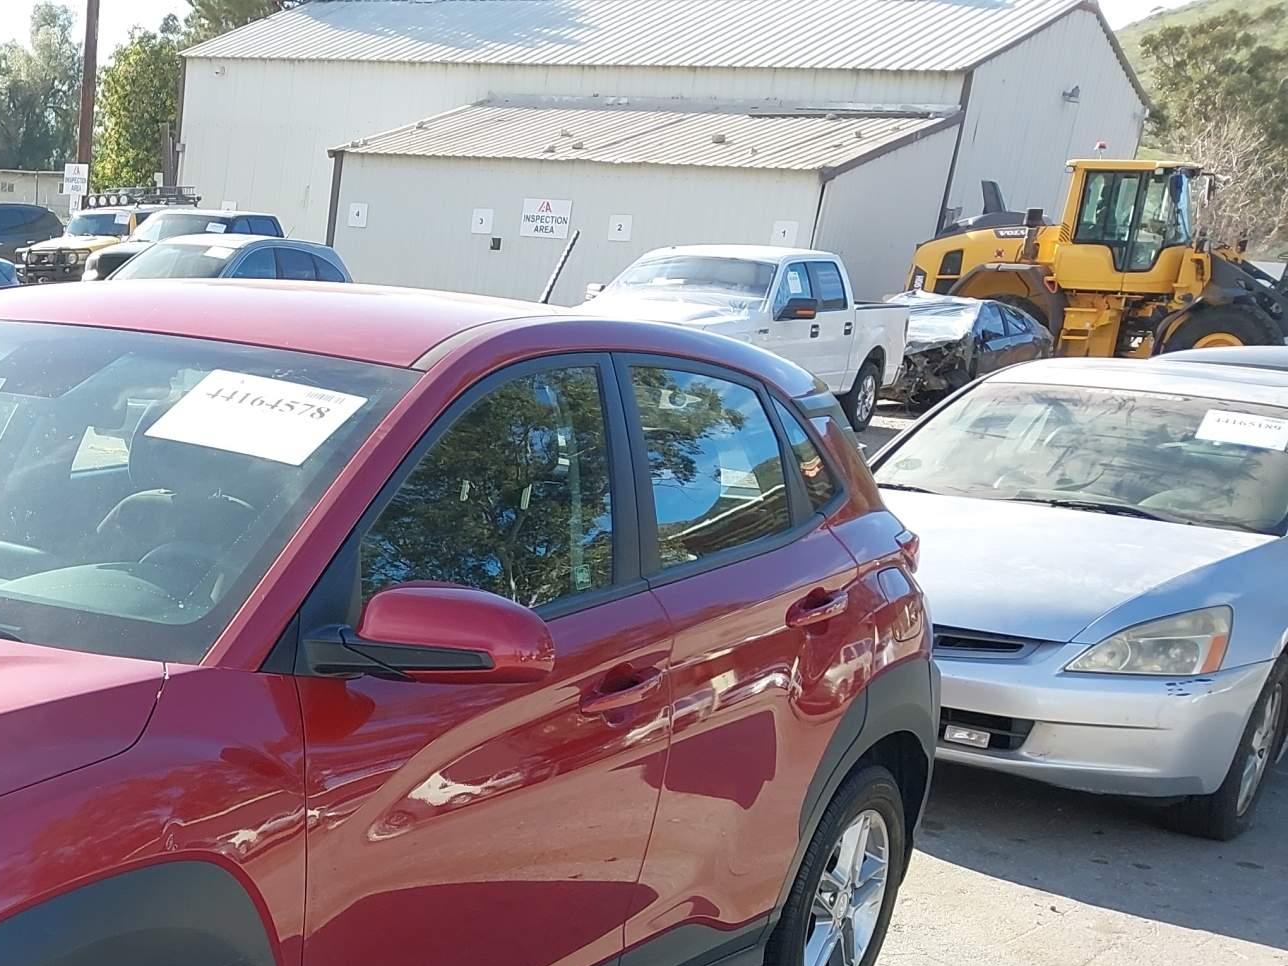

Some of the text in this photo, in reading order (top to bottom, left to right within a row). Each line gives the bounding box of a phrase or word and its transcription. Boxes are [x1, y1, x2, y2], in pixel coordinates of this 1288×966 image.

[355, 209, 361, 217] 4
[478, 217, 484, 225] 3
[523, 214, 568, 225] INSPECTION
[533, 225, 555, 234] AREA
[617, 223, 623, 232] 2
[781, 229, 787, 238] 1
[206, 387, 331, 420] 44164578
